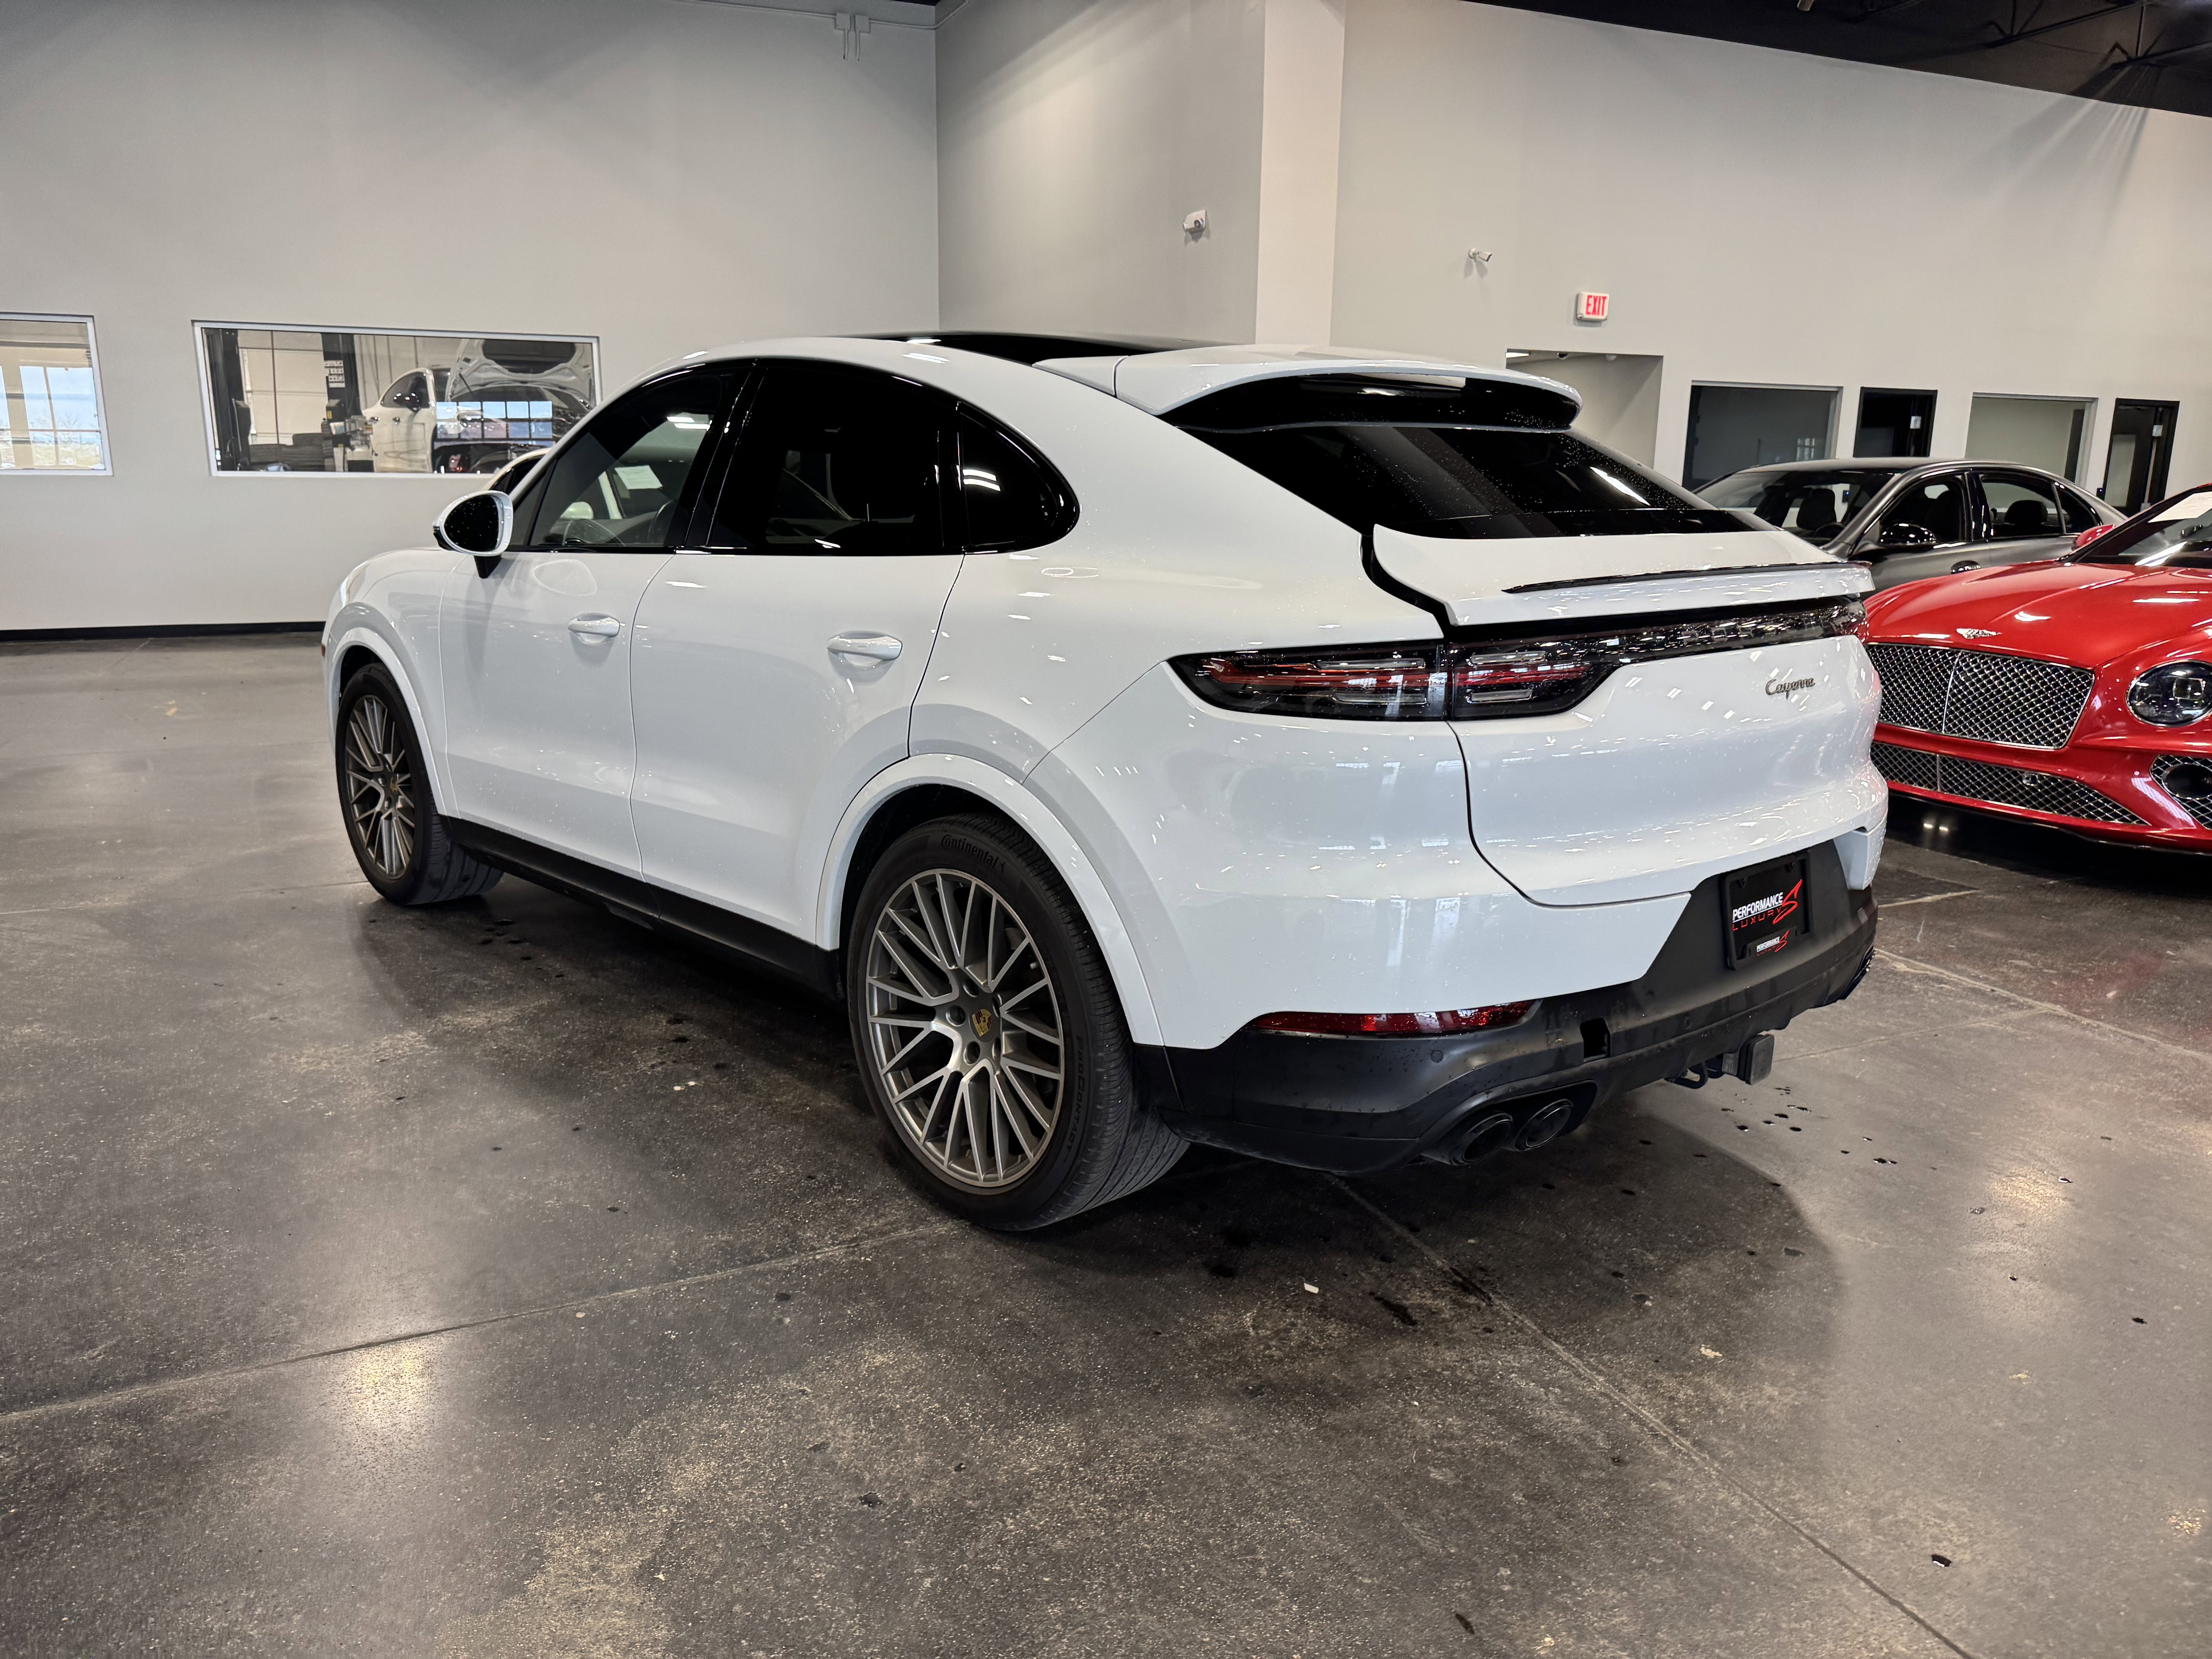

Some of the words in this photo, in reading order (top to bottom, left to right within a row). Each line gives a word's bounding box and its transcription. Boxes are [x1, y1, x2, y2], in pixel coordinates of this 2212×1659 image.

[1585, 295, 1607, 316] EXIT
[1765, 678, 1815, 699] Cayenne
[941, 834, 999, 868] Continental
[1732, 892, 1783, 921] PERFORMANCE
